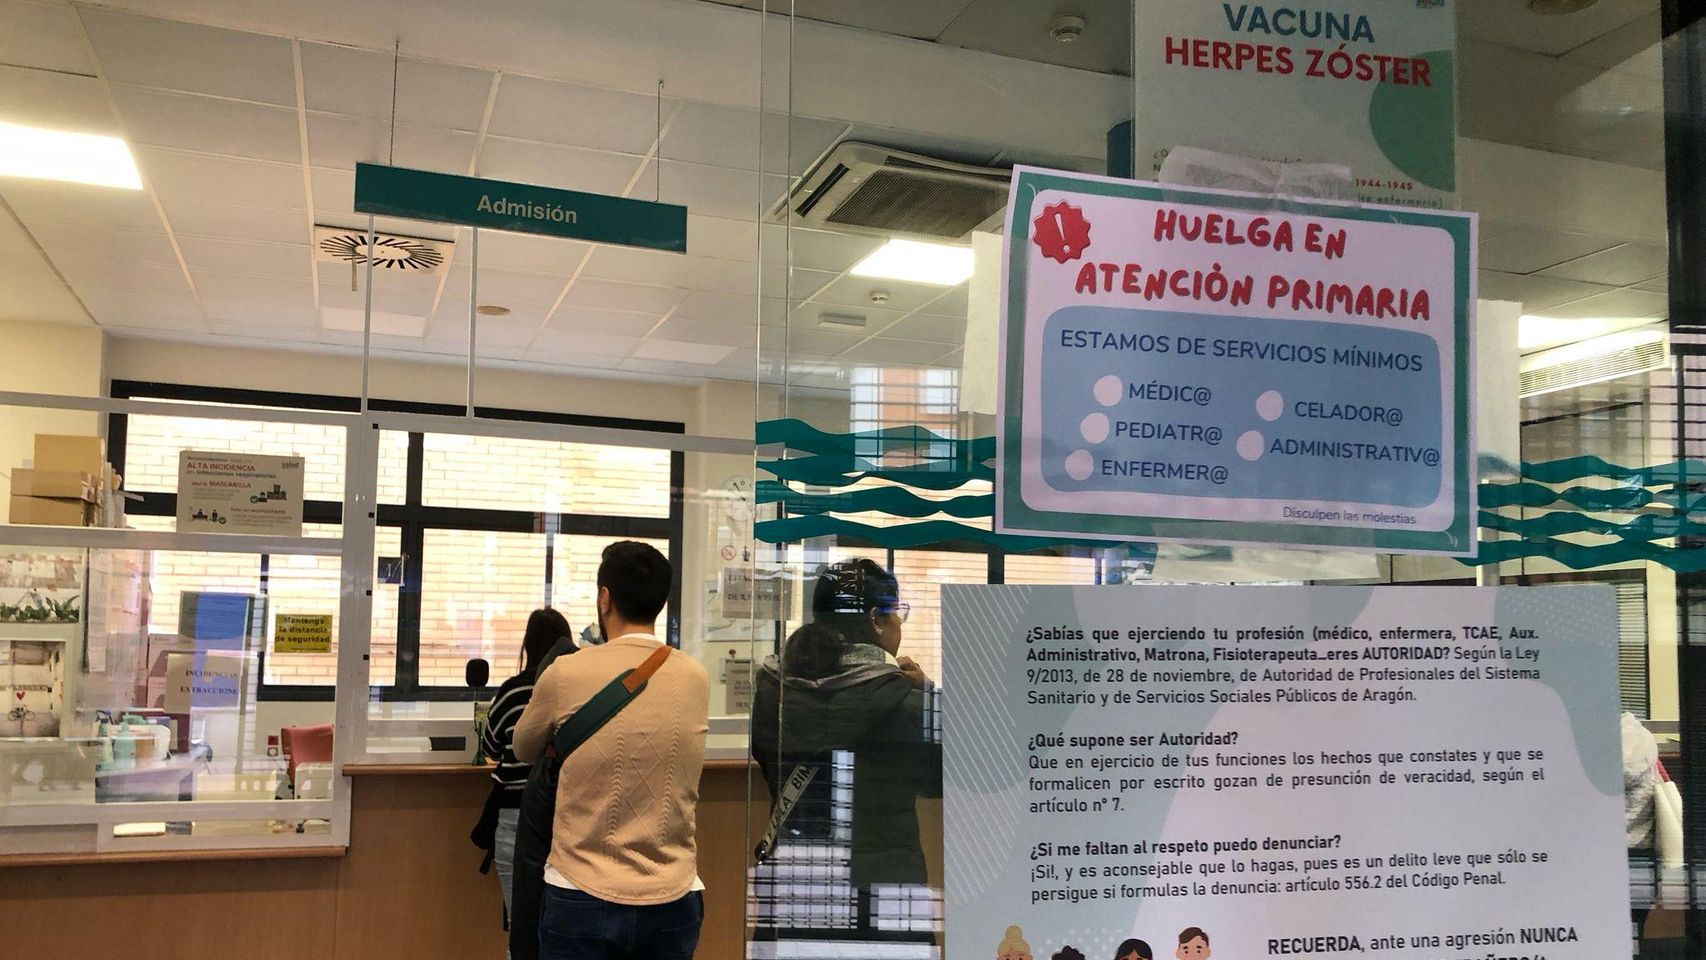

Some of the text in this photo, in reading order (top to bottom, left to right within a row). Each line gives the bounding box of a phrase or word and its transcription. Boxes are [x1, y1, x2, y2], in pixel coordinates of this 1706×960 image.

[1223, 3, 1375, 43] VACUNA
[1165, 36, 1432, 87] HERPES ZÓSTER
[1355, 178, 1413, 190] 1944-1945
[476, 194, 578, 225] Admisión
[1153, 208, 1347, 259] HUELGA EN
[1266, 274, 1430, 321] PRIMARIA
[1061, 329, 1423, 372] ESTAMOS DE SERVICIOS MÍNIMOS
[1128, 379, 1212, 407] MÉDIC@
[1294, 401, 1403, 427] CELADOR@
[1115, 421, 1223, 446] PEDIATR@
[1269, 440, 1440, 467] ADMINISTRATIV@
[187, 462, 256, 472] ALTA INCIDENCIA
[1101, 459, 1229, 485] ENFERMER@
[209, 481, 252, 489] MASCARILLA
[1283, 506, 1417, 525] Disculpen las molestias
[283, 616, 325, 625] Mantenga
[288, 636, 330, 644] seguridad
[1025, 624, 1539, 644] ¿Sabías que ejerciendo tu profesión (médico, enfermera, TCAE, Aux.
[1026, 647, 1140, 662] Administrativo,
[1144, 647, 1209, 663] Matrona,
[1361, 645, 1450, 660] AUTORIDAD?
[1453, 644, 1496, 662] Según
[1499, 646, 1512, 659] la
[1515, 647, 1539, 662] Ley
[1026, 666, 1540, 685] 9/2013, de 28 de noviembre, de Autoridad de Profesionales del Sistema
[1027, 685, 1416, 707] Sanitario y de Servicios Sociales Públicos de Aragón.
[1027, 730, 1238, 751] ¿Qué supone ser Autoridad?
[1028, 749, 1543, 772] Que en ejercicio de tus funciones los hechos que constates y que se
[1028, 766, 1544, 793] formalicen por escrito gozan de presunción de veracidad, según el
[1029, 796, 1087, 813] artículo
[1111, 796, 1124, 811] 7.
[1030, 834, 1341, 860] ¿Si me faltan al respeto puedo denunciar?
[1064, 867, 1073, 881] y
[1078, 866, 1096, 877] es
[1102, 860, 1193, 879] aconsejable
[1198, 862, 1225, 877] que
[1231, 858, 1245, 873] lo
[1250, 858, 1298, 875] hagas,
[1303, 858, 1338, 874] pues
[1343, 857, 1360, 869] es
[1365, 857, 1383, 868] un
[1388, 852, 1427, 867] delito
[1432, 852, 1461, 865] leve
[1466, 853, 1492, 867] que
[1496, 848, 1526, 863] sólo
[1531, 851, 1548, 862] se
[1031, 871, 1505, 904] persigue si formulas la denuncia: artículo 556.2 del Código Penal.
[1267, 926, 1578, 954] RECUERDA, ante una agresión NUNCA
